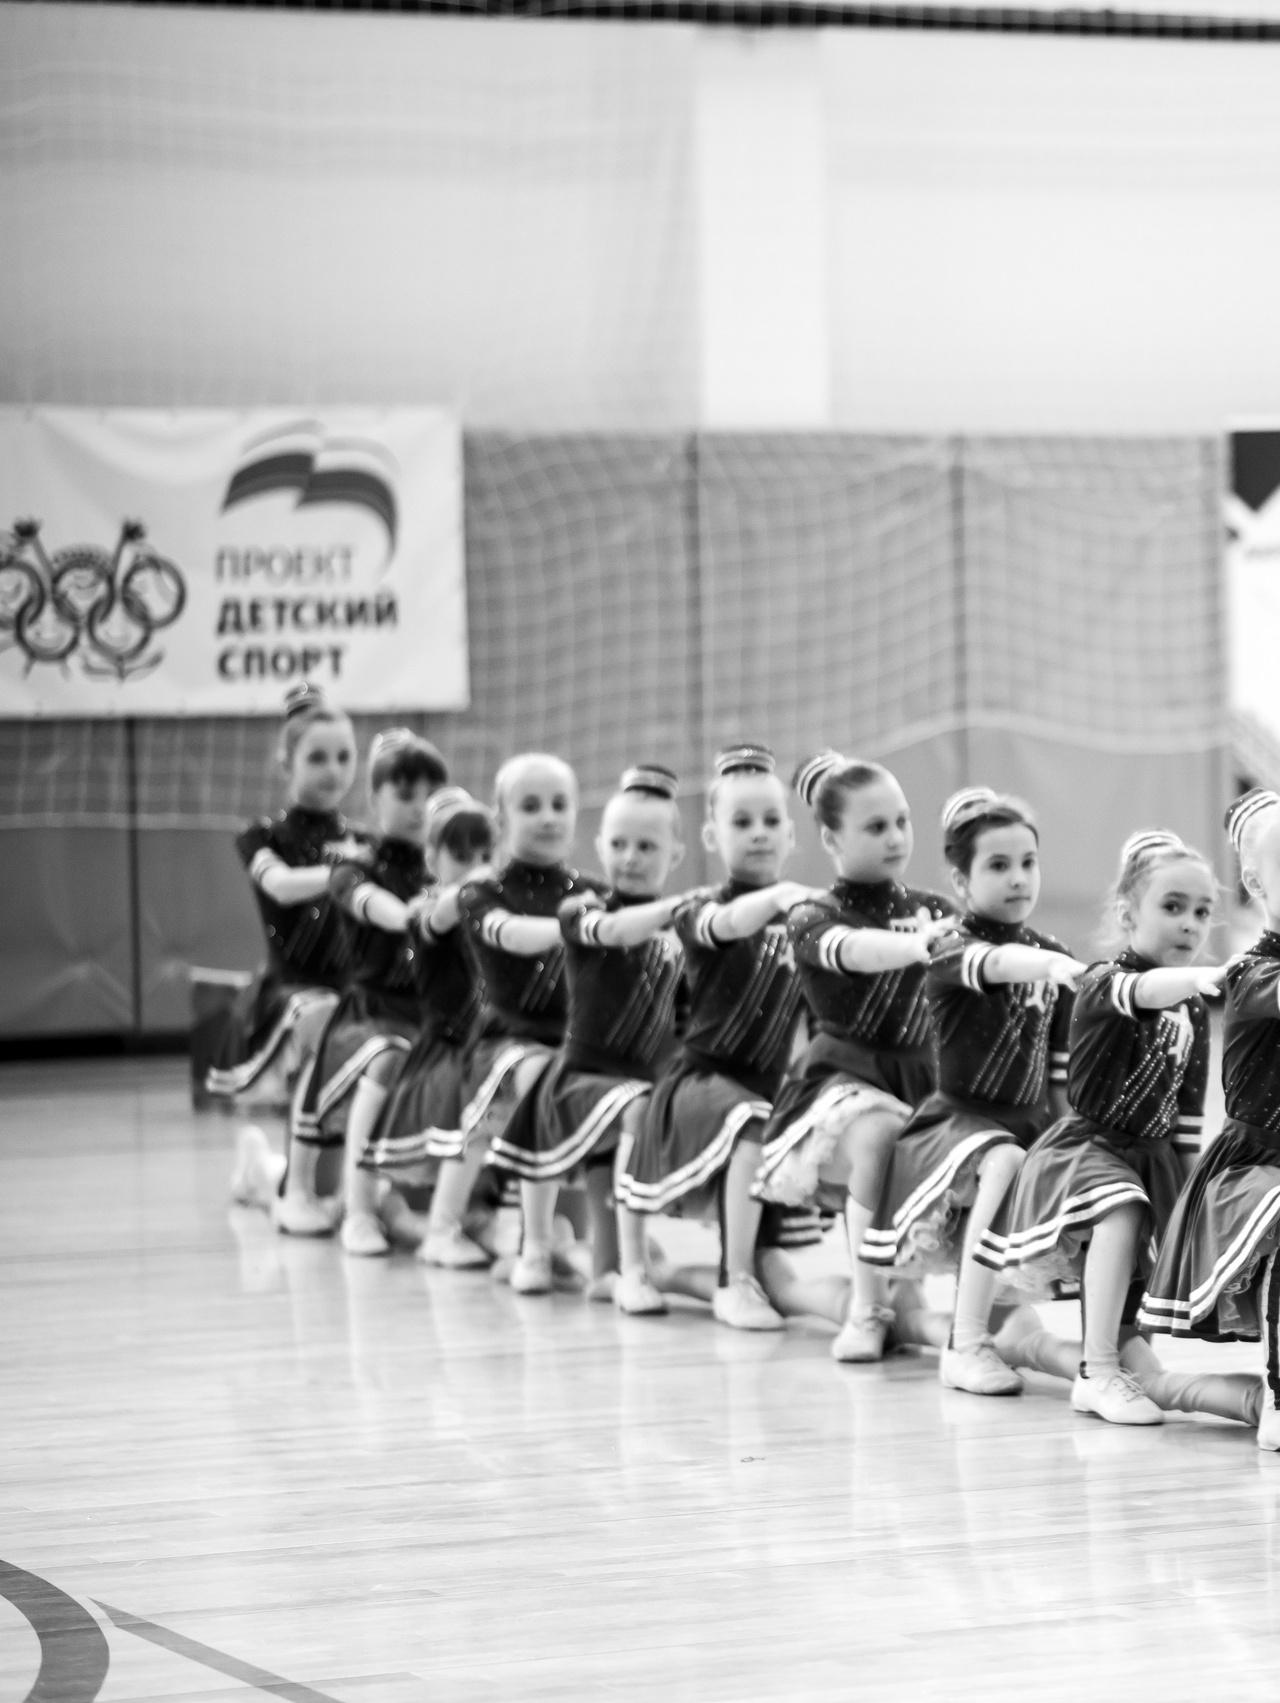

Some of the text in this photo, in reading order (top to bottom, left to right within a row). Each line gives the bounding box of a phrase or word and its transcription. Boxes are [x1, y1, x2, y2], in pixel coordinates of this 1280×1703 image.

[216, 546, 355, 586] ПРОЕКТ
[216, 590, 399, 637] ДЕТСКИЙ
[217, 645, 345, 681] СПОРТ
